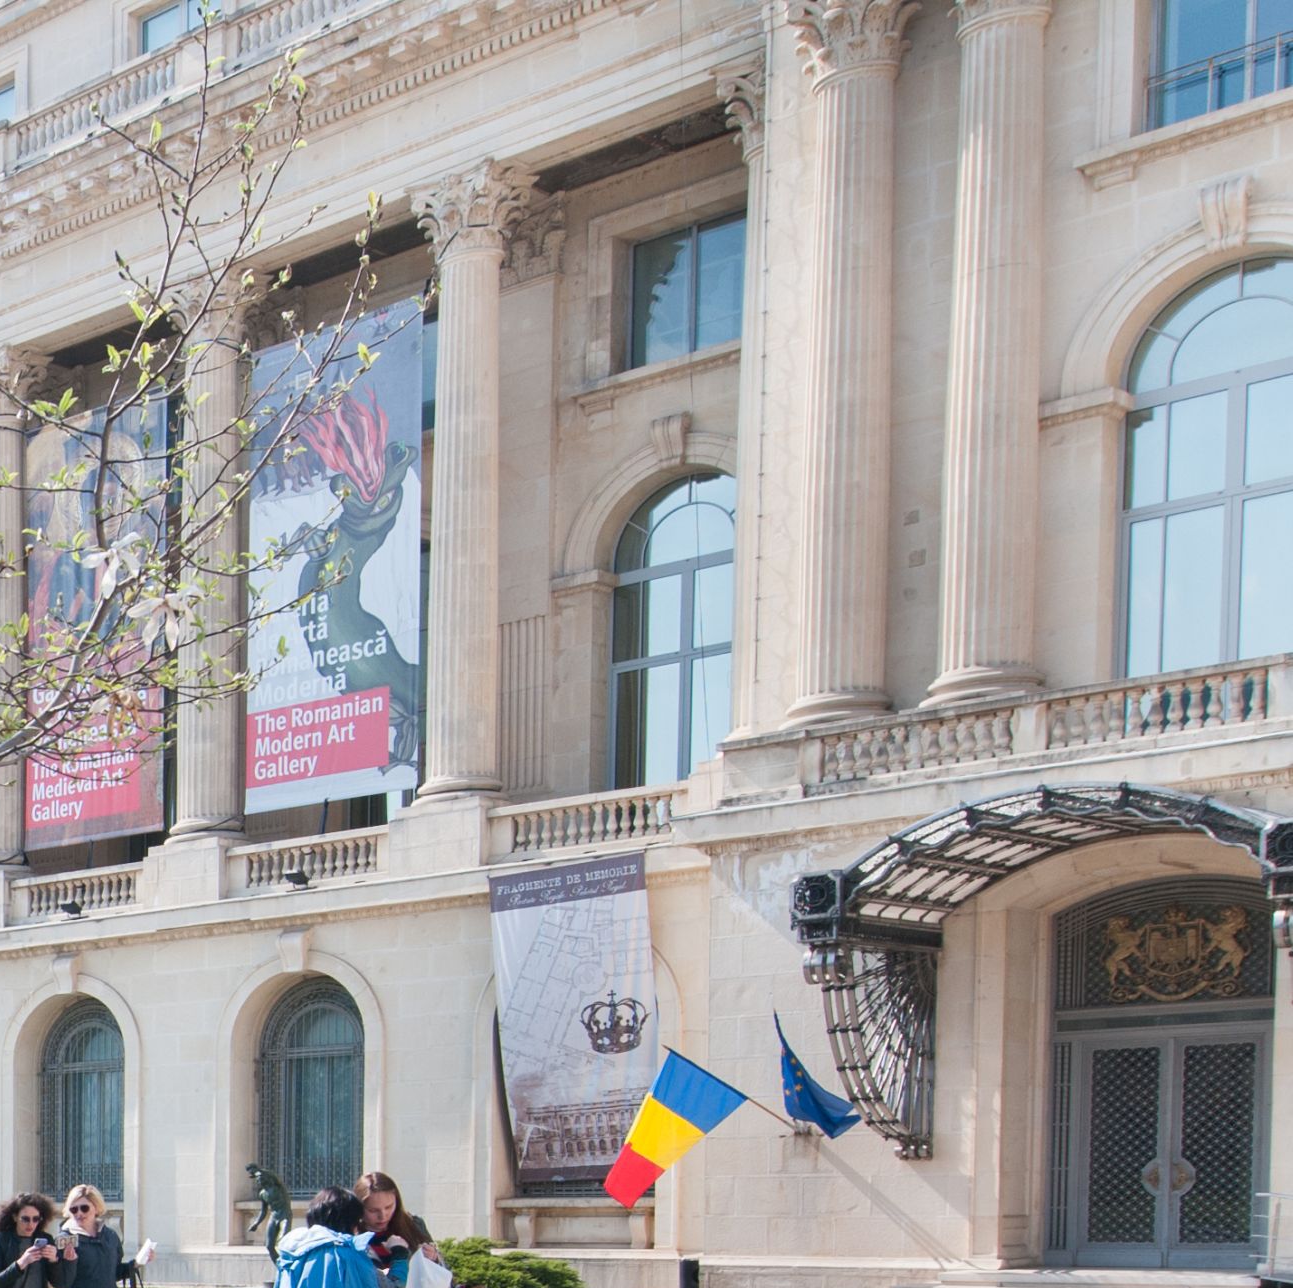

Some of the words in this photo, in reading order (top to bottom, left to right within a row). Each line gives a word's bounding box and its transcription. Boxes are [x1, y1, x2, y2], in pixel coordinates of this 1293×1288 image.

[254, 713, 287, 735] The
[291, 695, 383, 728] Romanian
[254, 731, 322, 758] Modern
[326, 721, 356, 745] Art
[31, 770, 98, 801] Medieval
[100, 767, 125, 789] Art
[32, 760, 58, 781] The
[254, 755, 318, 780] Gallery
[31, 799, 84, 822] Gallery
[497, 876, 562, 896] FRAGMENTE
[566, 873, 581, 885] DE
[585, 863, 638, 882] MEMORIE
